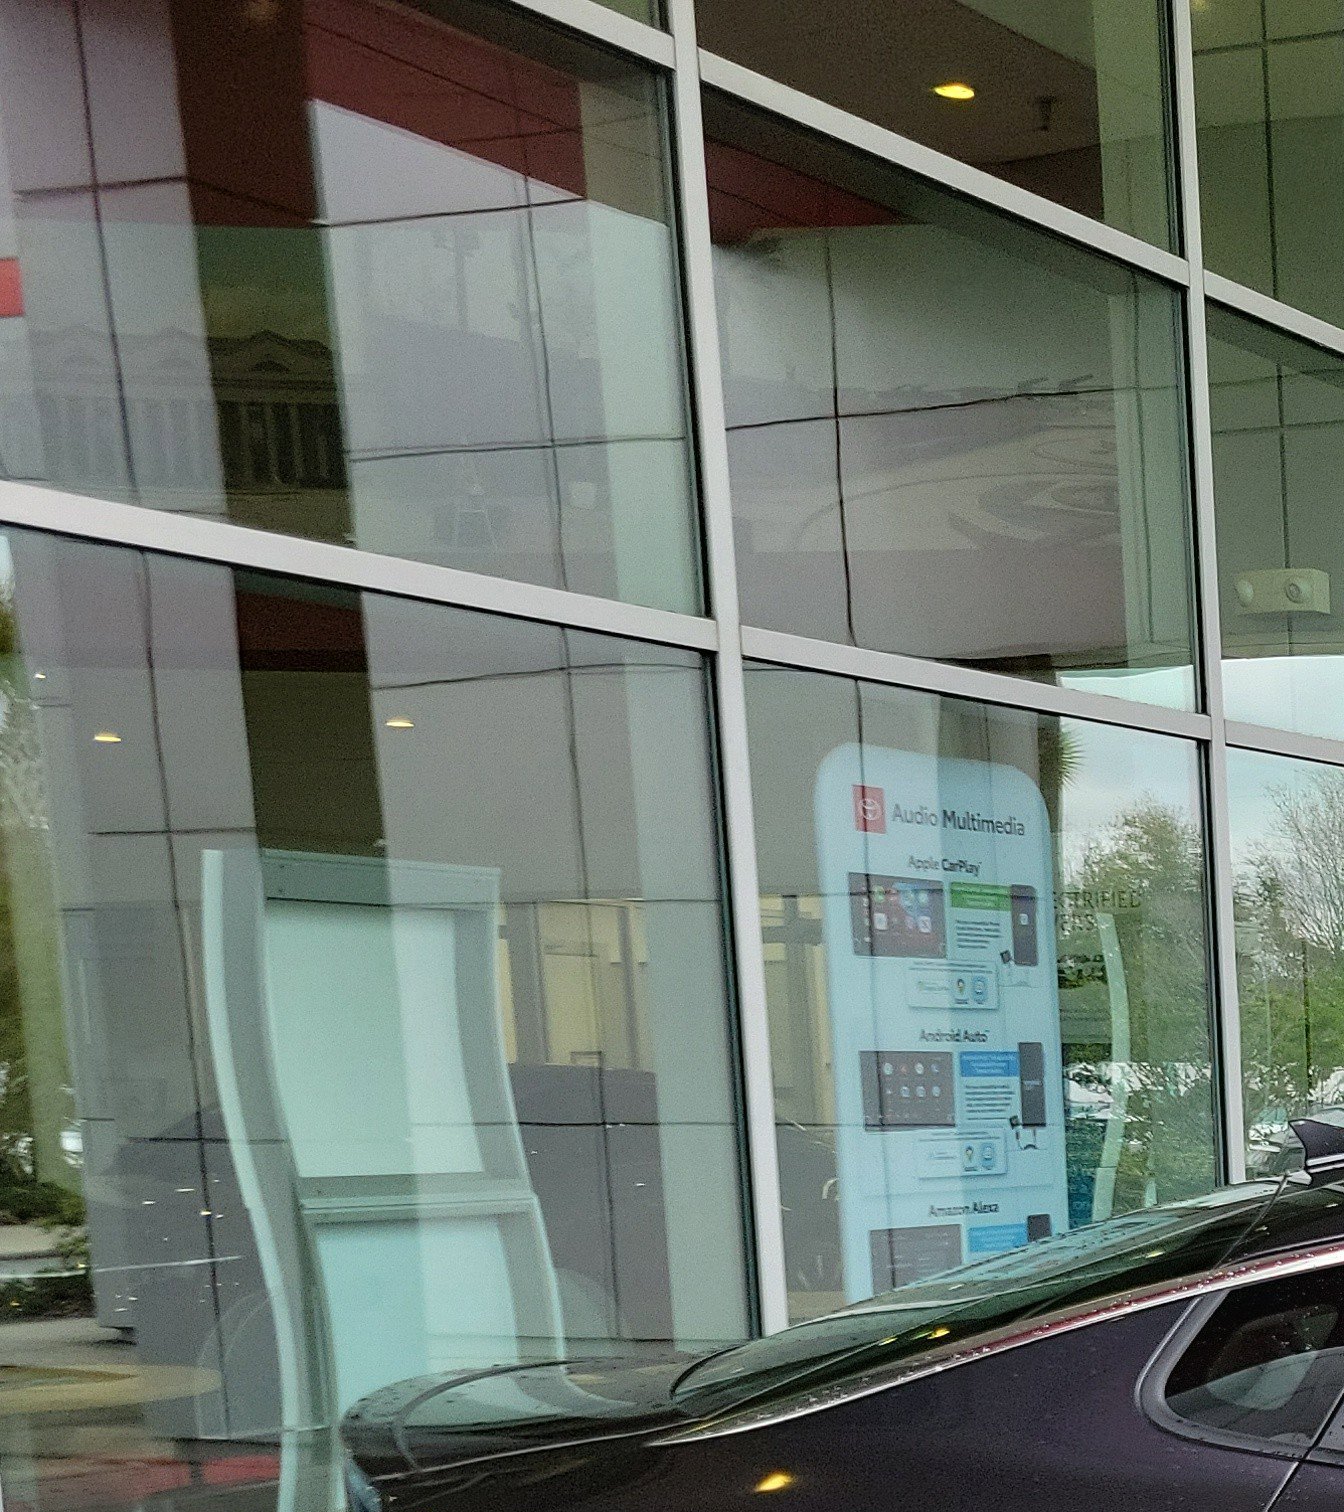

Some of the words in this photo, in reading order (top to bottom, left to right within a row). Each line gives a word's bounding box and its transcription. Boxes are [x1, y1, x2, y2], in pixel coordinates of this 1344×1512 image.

[891, 803, 939, 827] Audio
[942, 808, 1026, 836] Multimedia
[908, 855, 939, 872] Apple
[941, 858, 981, 877] CarPlay
